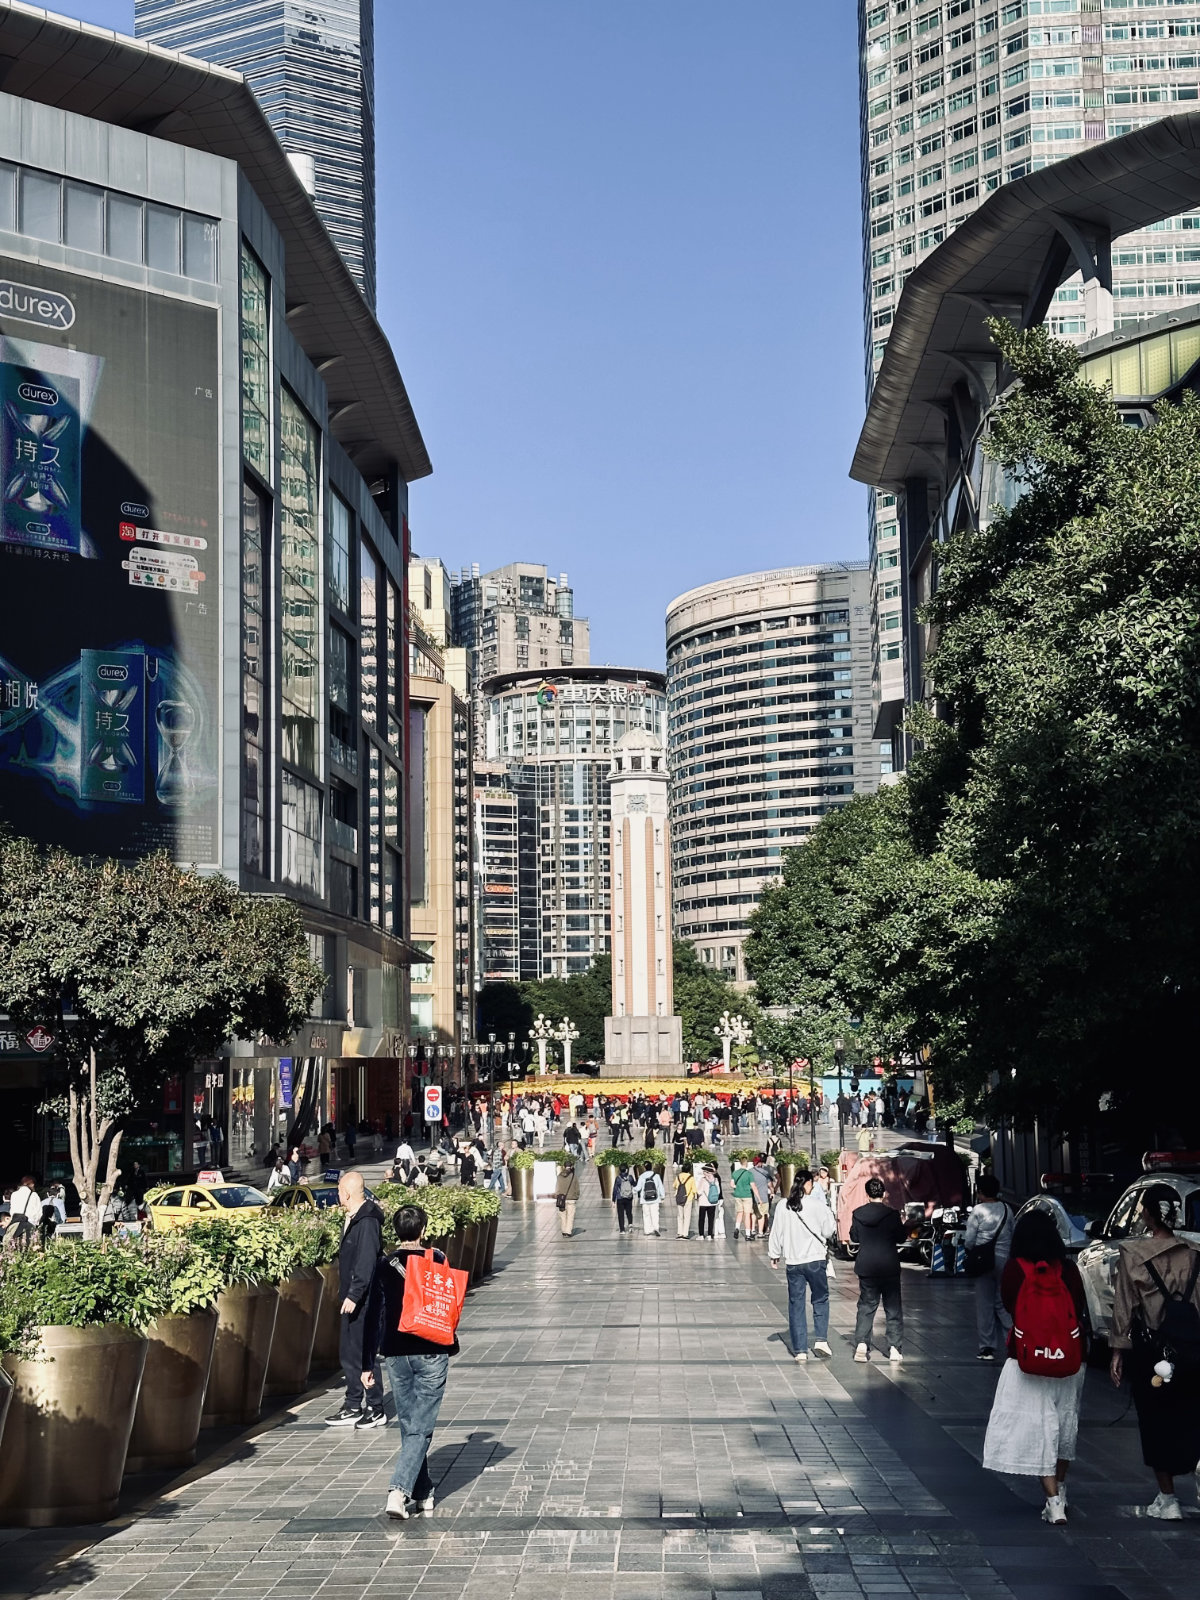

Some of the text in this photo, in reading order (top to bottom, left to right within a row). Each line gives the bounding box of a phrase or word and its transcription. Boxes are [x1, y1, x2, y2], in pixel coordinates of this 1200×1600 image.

[0, 286, 67, 323] durex
[22, 385, 56, 403] durex
[194, 386, 213, 399] 广告
[123, 504, 147, 516] durex
[185, 601, 208, 615] 广告
[99, 666, 128, 679] durex
[0, 679, 39, 710] 相悦
[562, 684, 646, 704] 重庆银行
[1034, 1347, 1065, 1359] FILA
